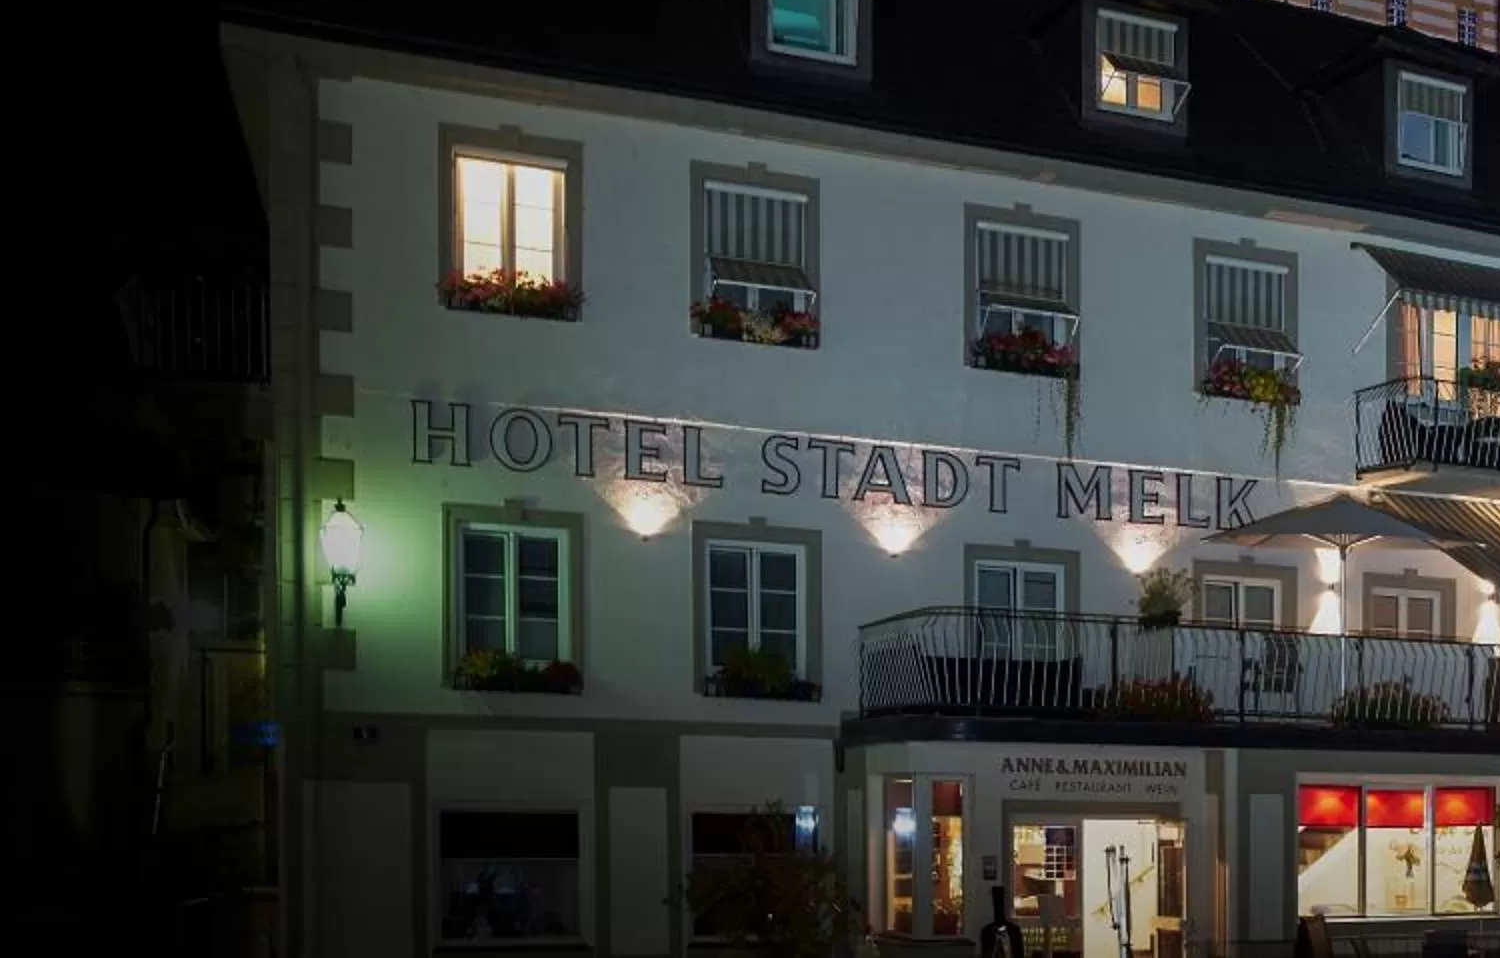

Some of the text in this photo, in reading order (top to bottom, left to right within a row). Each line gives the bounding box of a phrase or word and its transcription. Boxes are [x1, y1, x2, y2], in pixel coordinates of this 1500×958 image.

[410, 399, 1259, 530] HOTEL STADT MELK
